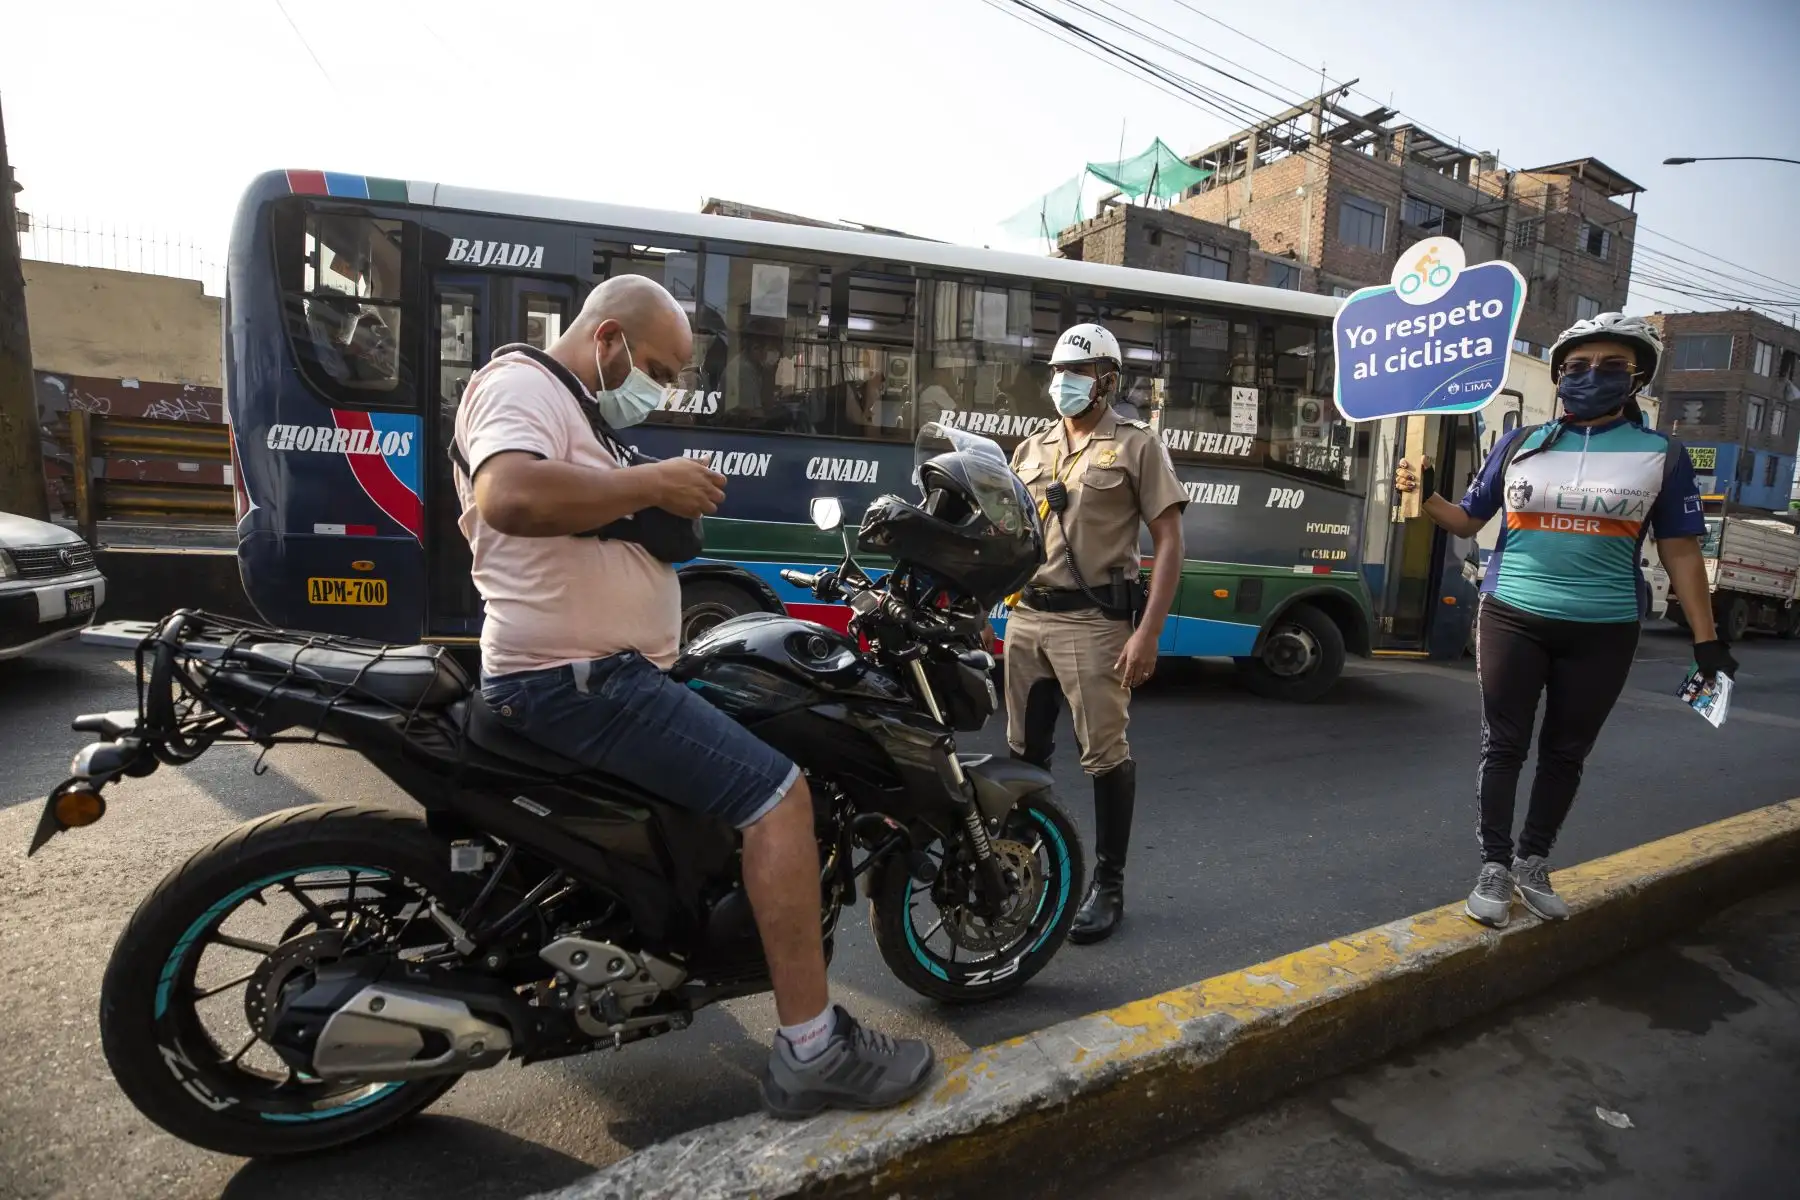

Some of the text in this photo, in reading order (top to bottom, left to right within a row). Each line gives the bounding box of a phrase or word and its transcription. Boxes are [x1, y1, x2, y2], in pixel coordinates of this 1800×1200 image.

[445, 238, 544, 269] BAJADA
[1345, 299, 1503, 349] Yo respeto
[1353, 336, 1492, 380] al ciclista
[1464, 381, 1493, 393] LIMA
[267, 424, 414, 457] CHORRILLOS
[1162, 428, 1253, 457] SAN FELIPE
[806, 457, 879, 483] CANADA
[1265, 487, 1305, 509] PRO
[1556, 492, 1644, 517] LIMA
[1306, 522, 1350, 535] HYUNDAI
[1540, 515, 1601, 533] LÍDER
[312, 580, 384, 603] APM-700
[966, 810, 990, 860] YAMAHA
